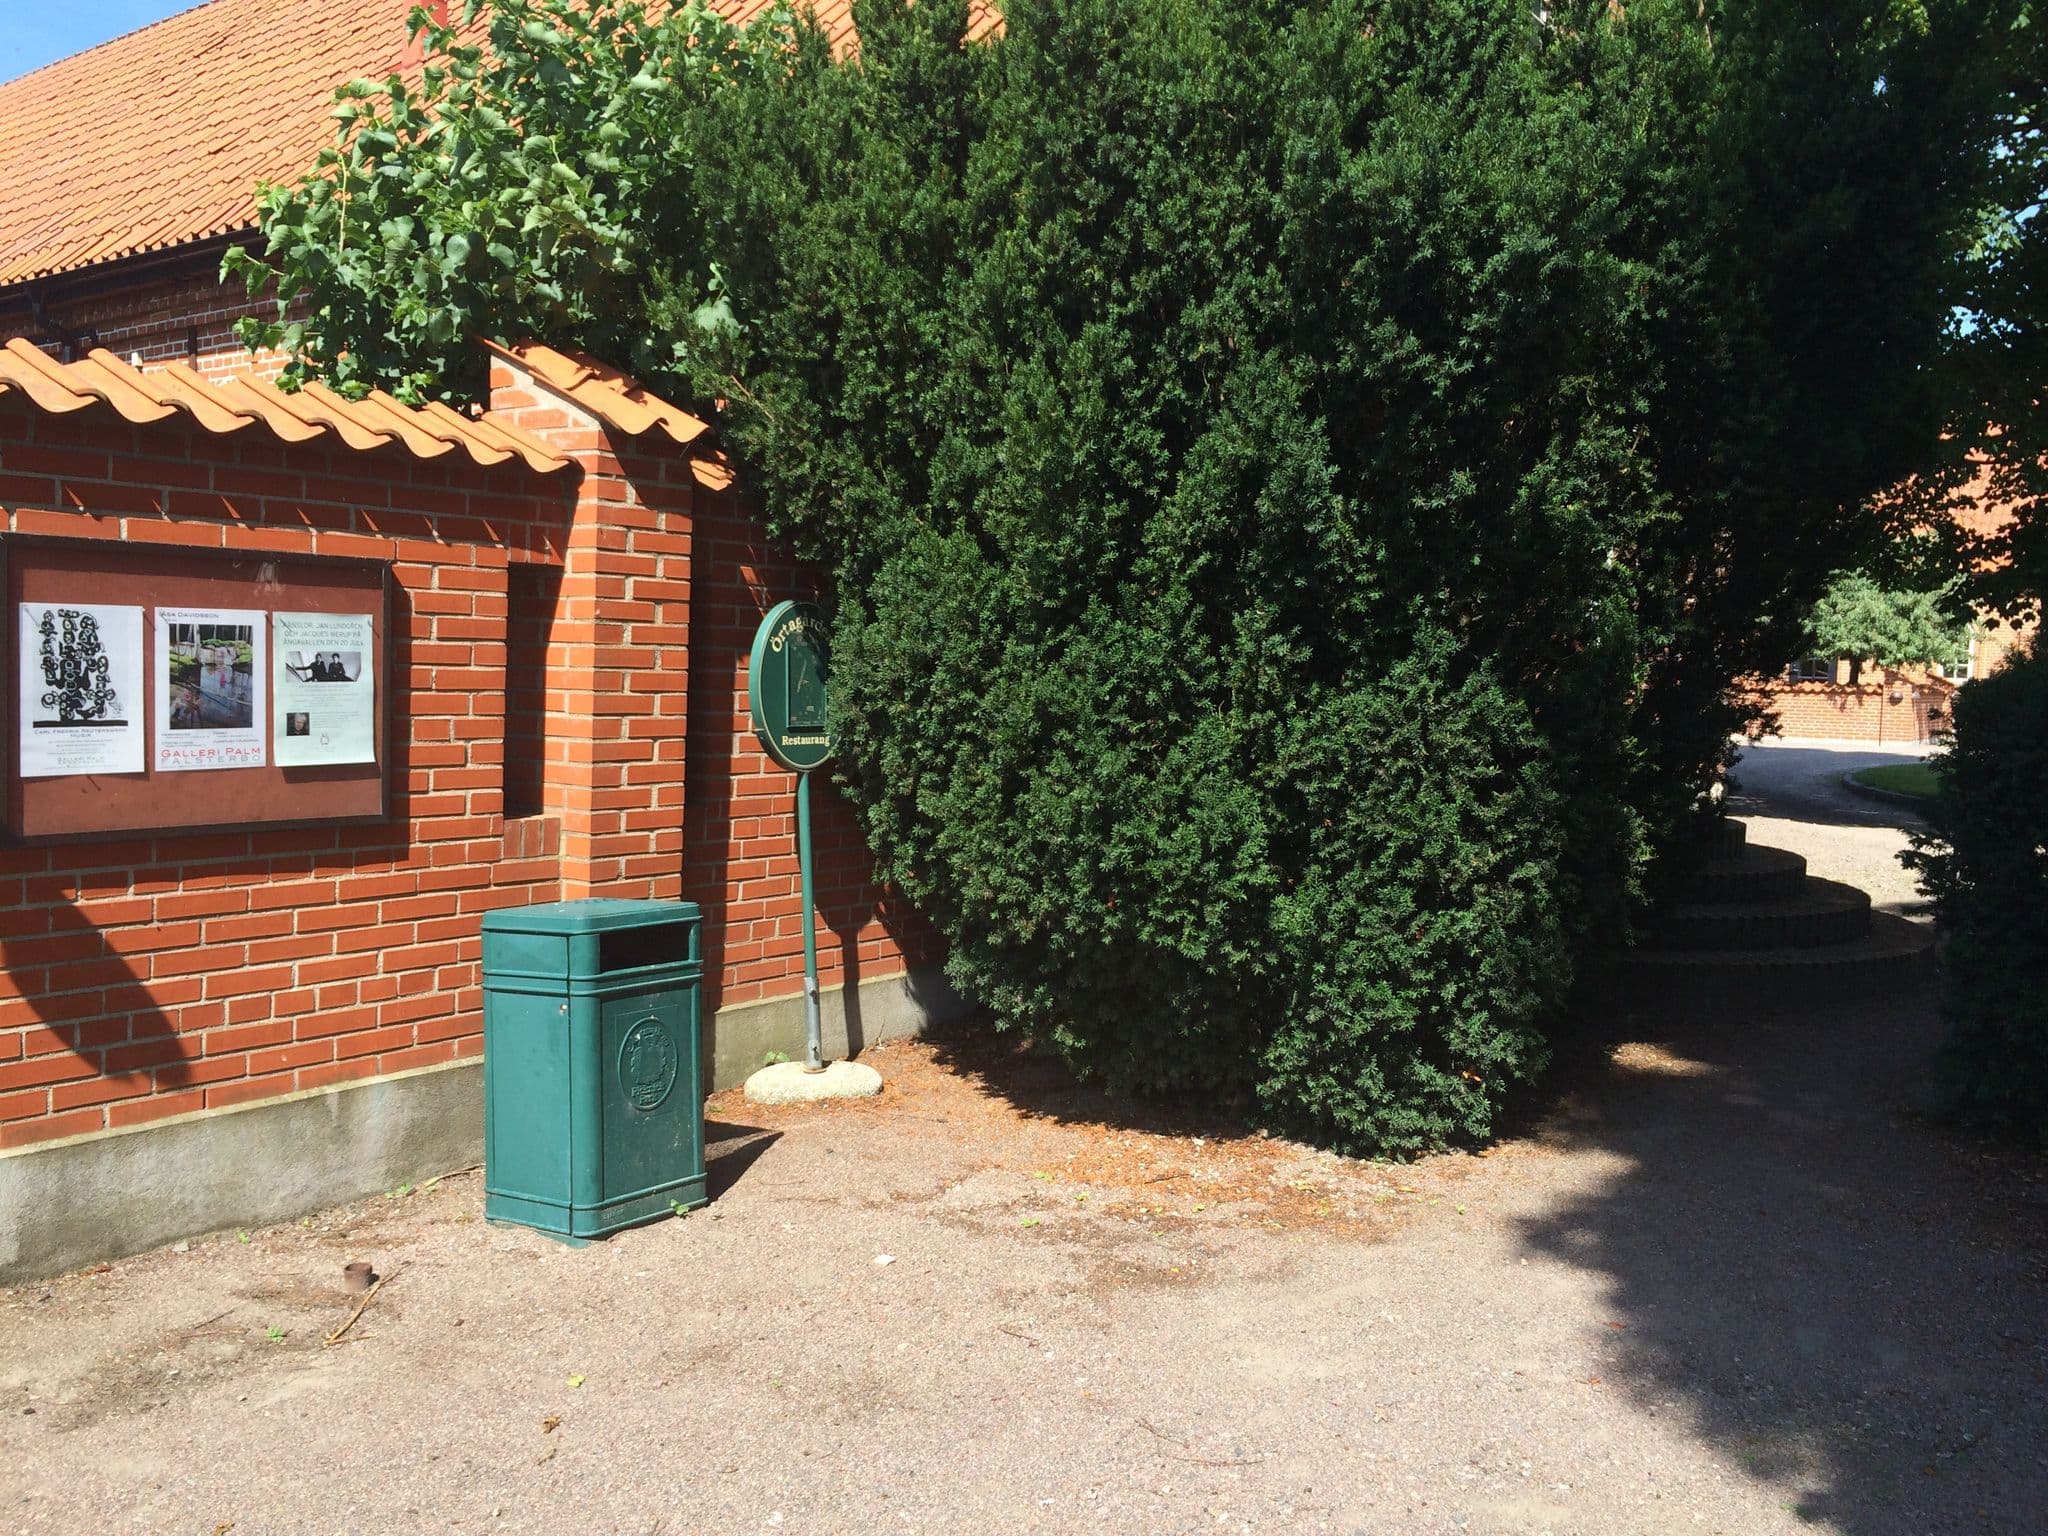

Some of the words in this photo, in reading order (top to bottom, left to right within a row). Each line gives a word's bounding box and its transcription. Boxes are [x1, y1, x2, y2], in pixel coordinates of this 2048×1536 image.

[770, 613, 831, 652] Örtagårde
[781, 735, 831, 747] Restaurang
[161, 749, 220, 758] GALLERI
[225, 747, 261, 756] PALM
[161, 755, 261, 765] FALSTERBO
